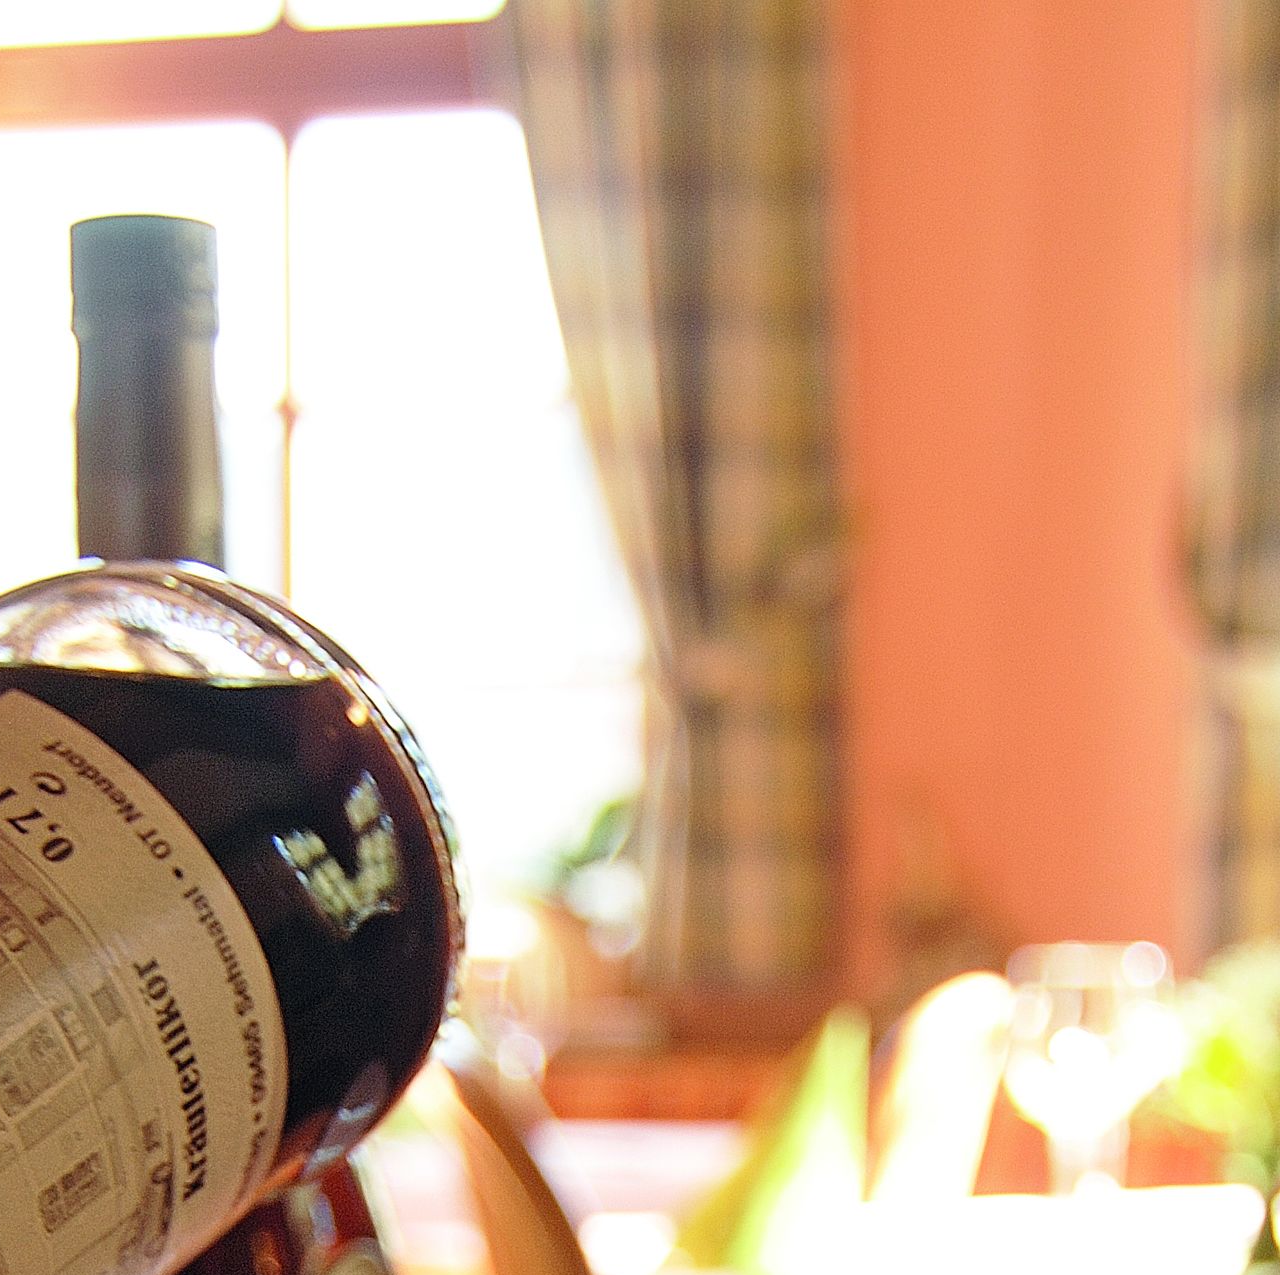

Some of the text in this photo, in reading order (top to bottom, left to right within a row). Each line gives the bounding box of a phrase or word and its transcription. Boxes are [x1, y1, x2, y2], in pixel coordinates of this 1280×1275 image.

[40, 740, 144, 825] Neudorf
[136, 828, 172, 861] OT
[131, 957, 208, 1202] Kräuterlikör
